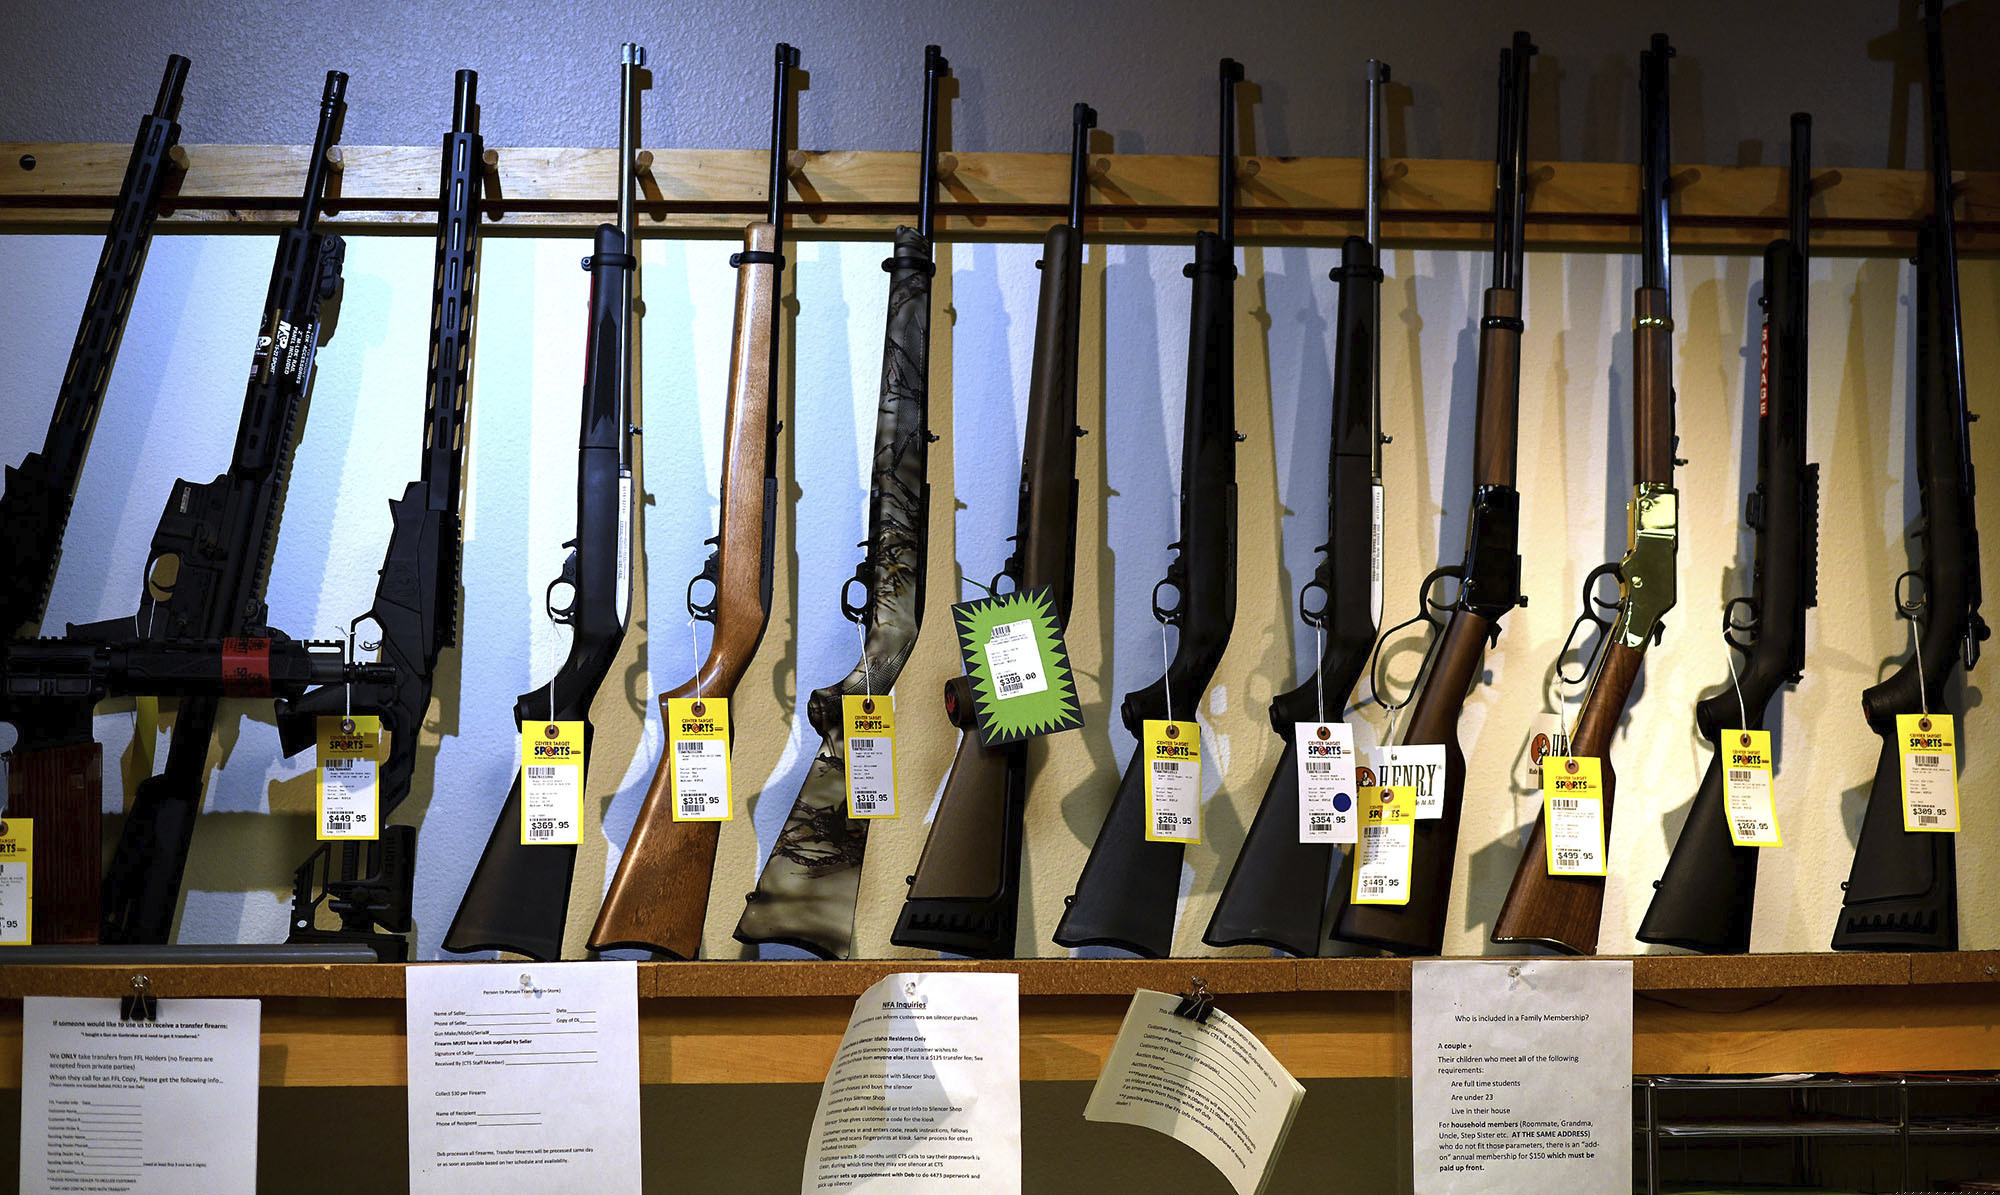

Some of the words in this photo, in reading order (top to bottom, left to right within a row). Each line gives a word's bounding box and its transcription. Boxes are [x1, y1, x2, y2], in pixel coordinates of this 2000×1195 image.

[1000, 672, 1036, 686] $399.00
[683, 797, 719, 805] $319.95
[857, 794, 888, 802] $319.95
[329, 814, 366, 823] $449.95
[1158, 816, 1192, 824] $263.95
[1311, 816, 1346, 824] $354.95
[532, 821, 569, 830] $369.95
[1363, 879, 1399, 887] $449.95
[1521, 1014, 1542, 1022] Family
[1544, 1014, 1589, 1022] Membership?
[1444, 1042, 1467, 1050] couple
[1548, 1055, 1579, 1063] following
[1461, 1132, 1476, 1140] Step
[1440, 1165, 1454, 1173] paid
